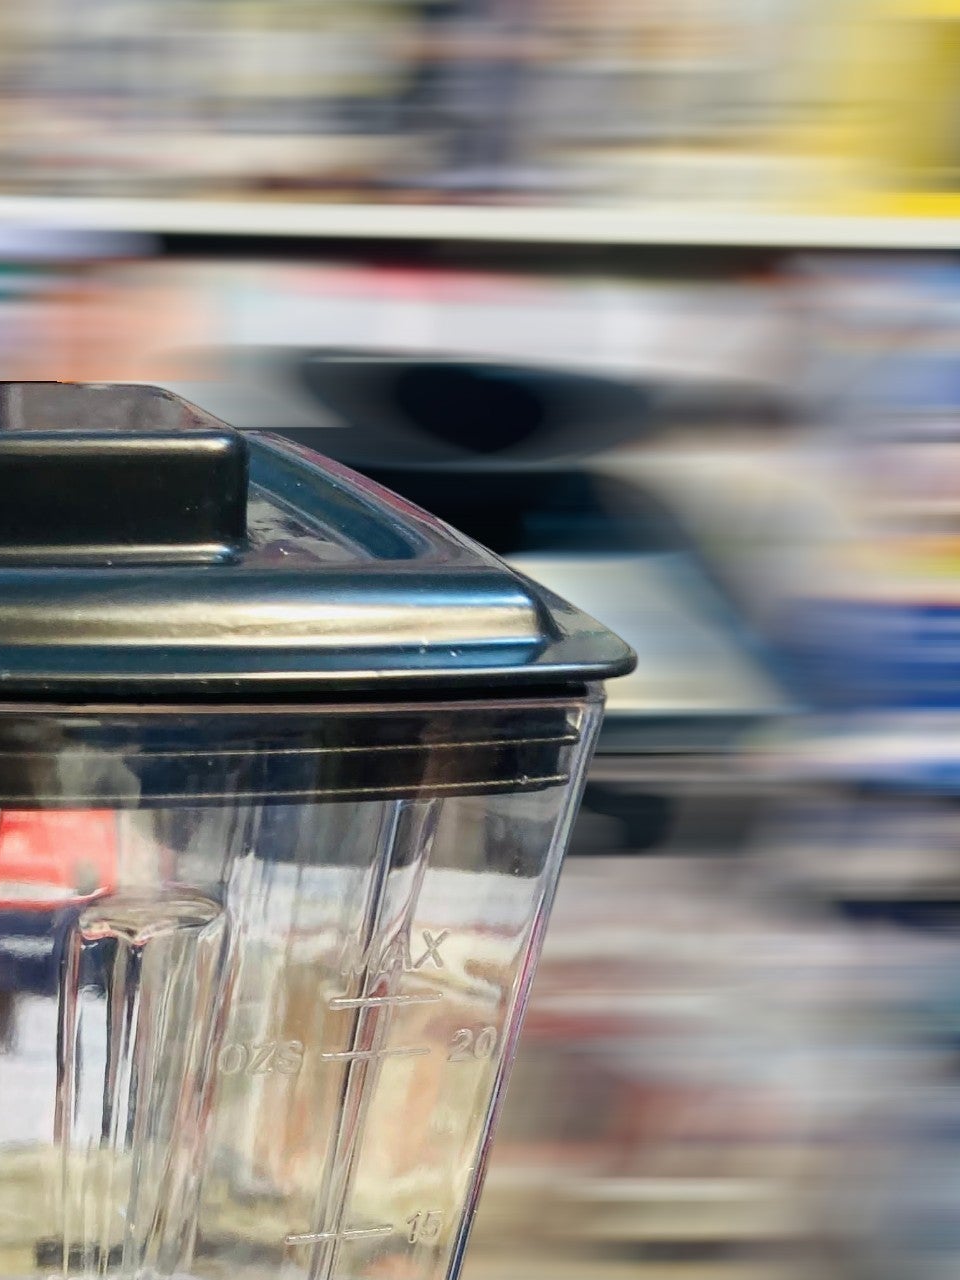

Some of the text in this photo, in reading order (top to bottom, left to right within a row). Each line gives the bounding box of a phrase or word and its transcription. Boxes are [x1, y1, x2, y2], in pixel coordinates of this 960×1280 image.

[218, 1027, 498, 1076] OZS 20
[406, 1209, 443, 1245] 15
